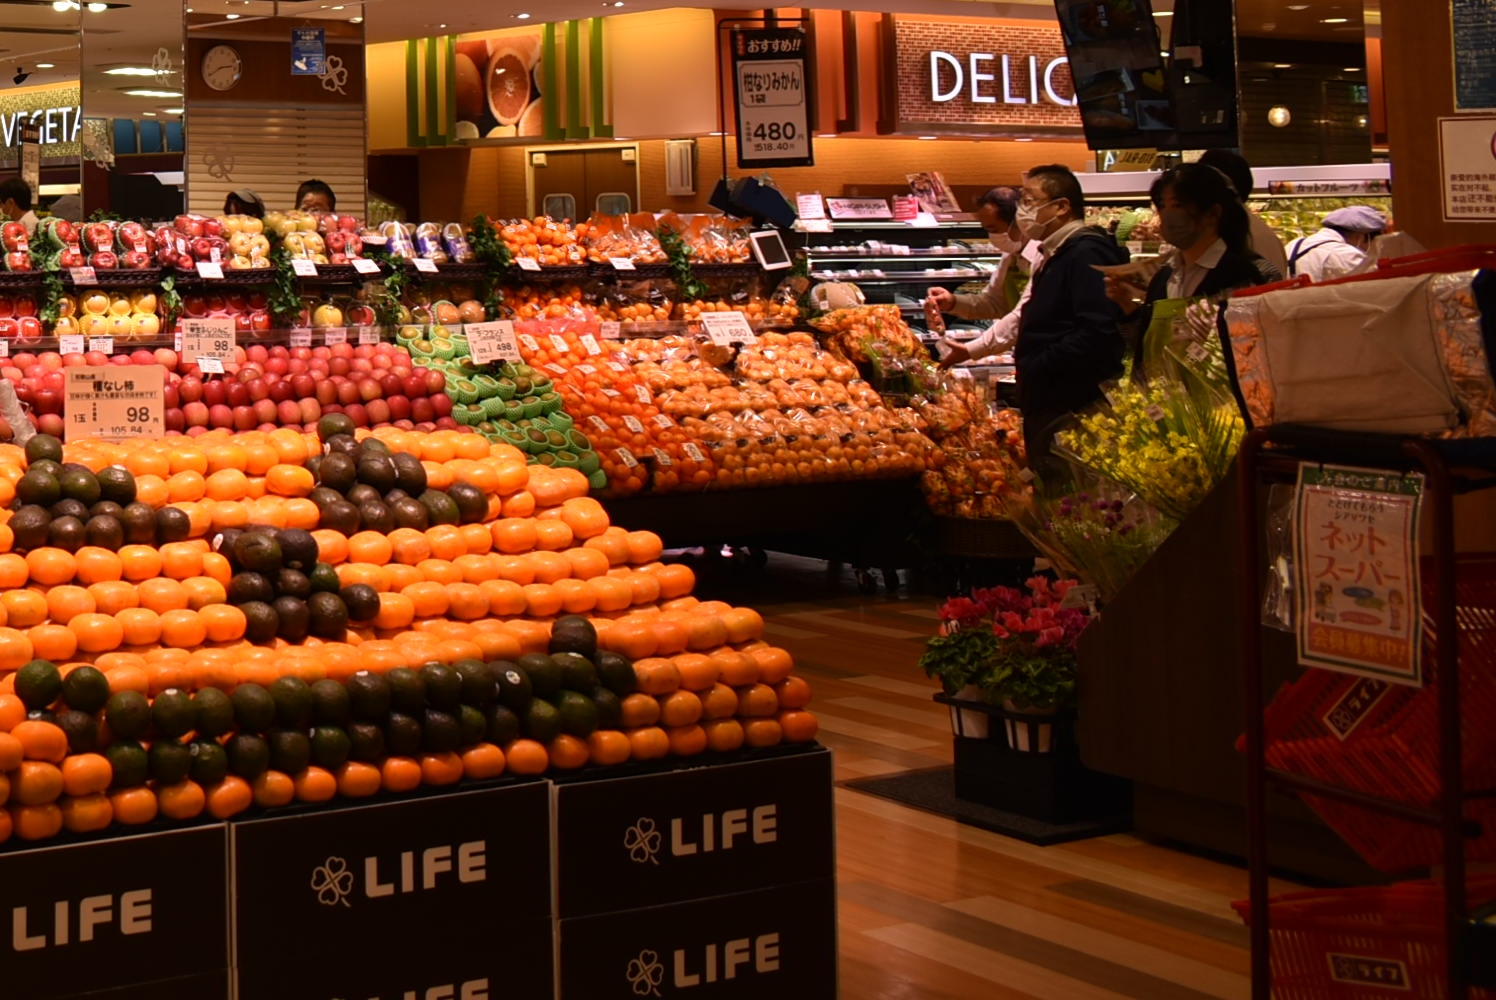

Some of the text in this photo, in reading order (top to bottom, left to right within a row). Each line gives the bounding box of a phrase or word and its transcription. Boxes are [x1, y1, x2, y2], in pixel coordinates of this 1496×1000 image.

[930, 51, 1078, 106] DELIC
[754, 121, 796, 141] 480
[214, 340, 229, 351] 98
[93, 380, 135, 392] 種なし柿
[73, 413, 86, 423] 1玉
[127, 406, 150, 423] 98
[1319, 520, 1386, 556] ネット
[1315, 554, 1401, 586] スーパー
[672, 804, 777, 857] LIFE
[364, 840, 486, 898] LIFE
[12, 888, 152, 951] LIFE
[674, 932, 780, 988] LIFE
